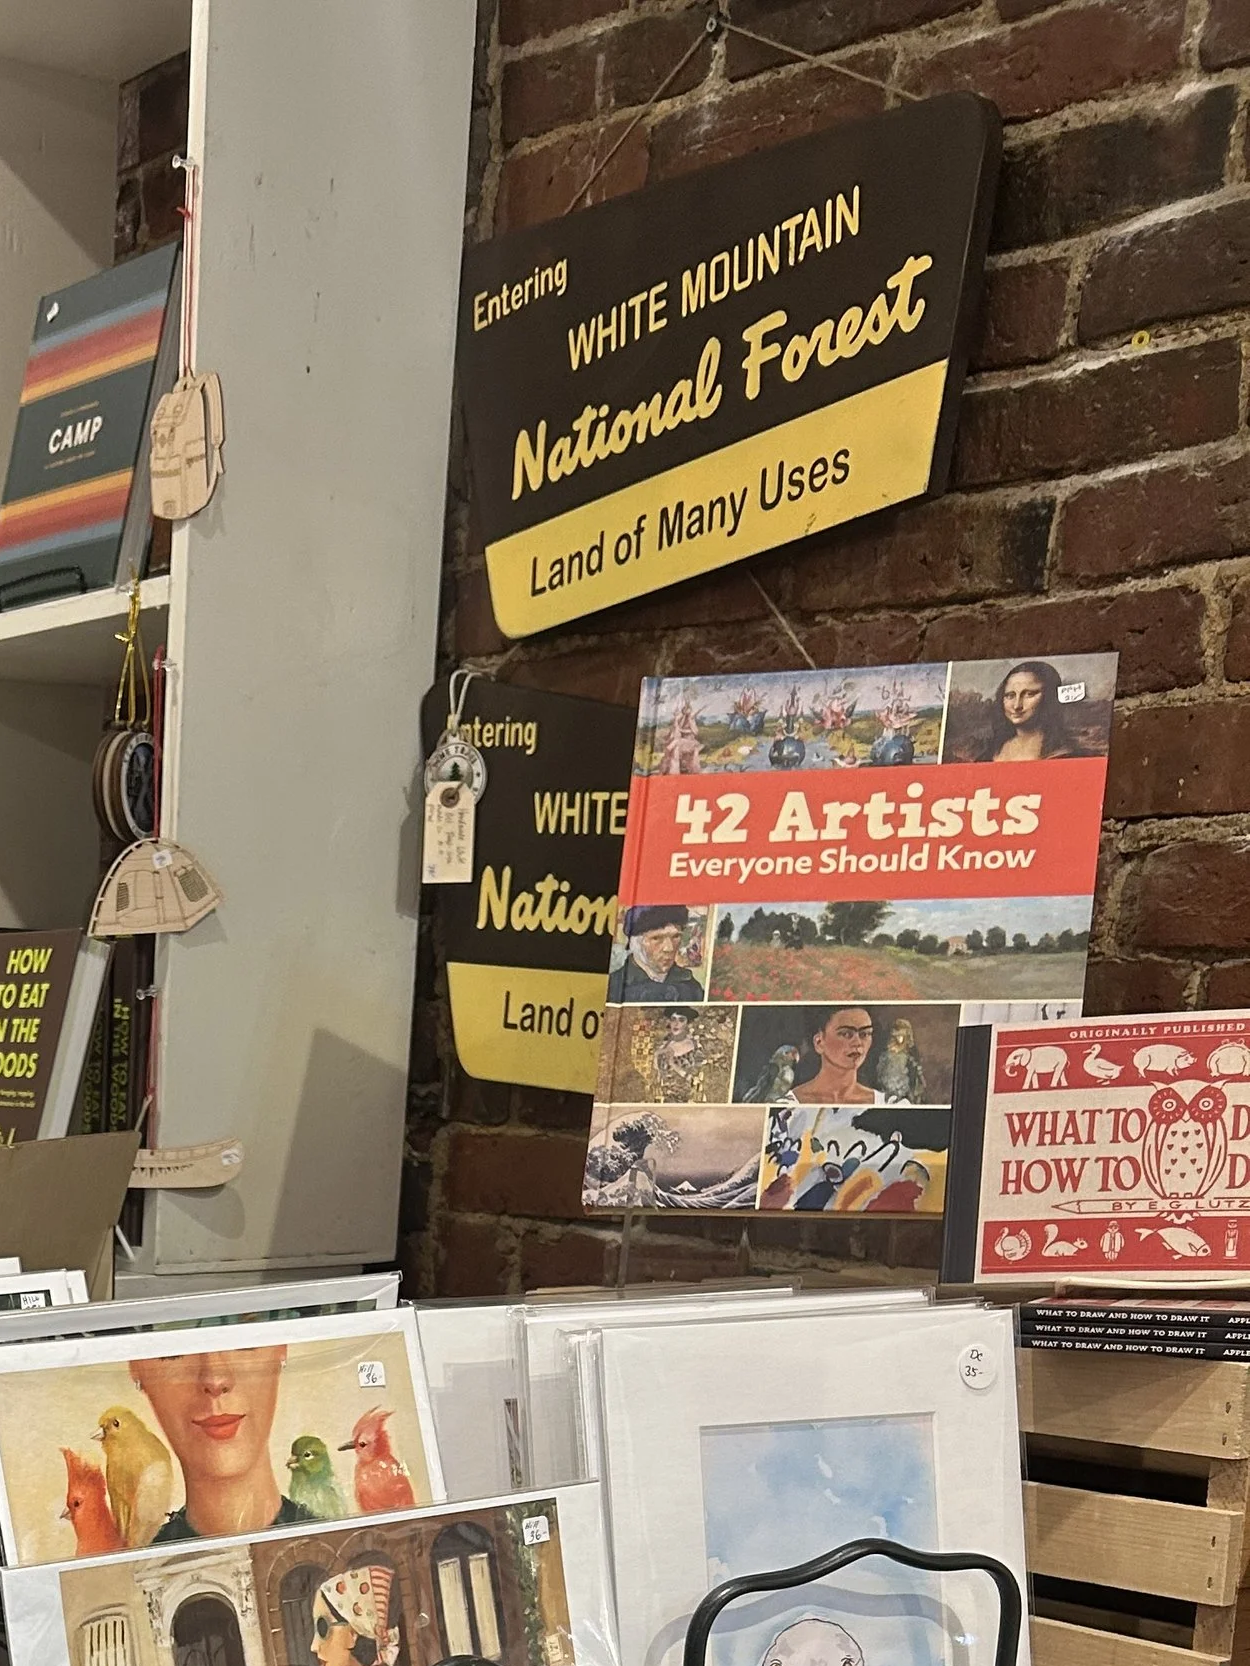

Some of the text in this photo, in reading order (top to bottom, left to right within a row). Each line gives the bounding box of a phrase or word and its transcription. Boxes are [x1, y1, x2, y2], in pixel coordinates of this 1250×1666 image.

[473, 257, 568, 332] Entering
[568, 185, 860, 370] WHITE MOUNTAIN
[512, 254, 933, 500] National Forest
[49, 415, 103, 454] CAMP
[530, 449, 850, 597] Land of Many Uses
[534, 791, 629, 835] WHITE
[675, 782, 1042, 844] 42 Artists
[669, 843, 1036, 884] Everyone Should Know
[6, 948, 53, 975] HOW
[18, 983, 50, 1009] EAT
[503, 991, 605, 1040] Land o
[10, 1019, 41, 1044] THE
[1069, 1022, 1246, 1039] ORIGINALLY PUBLISHED
[1004, 1109, 1103, 1148] WHAT
[1107, 1105, 1147, 1144] TO
[1000, 1158, 1090, 1195] HOW
[1095, 1156, 1141, 1192] TO
[1112, 1201, 1135, 1211] BY
[1195, 1199, 1250, 1210] LUTZ
[1035, 1324, 1062, 1332] WHAT
[1064, 1325, 1076, 1333] TO
[1078, 1326, 1105, 1334] DRAW
[1106, 1327, 1126, 1335] AND
[1128, 1328, 1151, 1336] HOW
[1153, 1329, 1166, 1337] TO
[1168, 1330, 1196, 1338] DRAW
[1197, 1331, 1207, 1339] IT
[1036, 1309, 1063, 1317] WHAT
[1065, 1310, 1078, 1318] TO
[1080, 1311, 1107, 1319] DRAW
[1108, 1312, 1128, 1320] AND
[1130, 1313, 1153, 1321] HOW
[1155, 1314, 1168, 1322] TO
[1170, 1314, 1199, 1323] DRAW
[1031, 1340, 1059, 1348] WHAT
[1061, 1341, 1073, 1349] TO
[1075, 1342, 1102, 1350] DRAW
[1103, 1343, 1123, 1351] AND
[1125, 1344, 1148, 1352] HOW
[1150, 1345, 1163, 1353] TO
[1165, 1346, 1193, 1355] DRAW
[1195, 1347, 1205, 1355] IT
